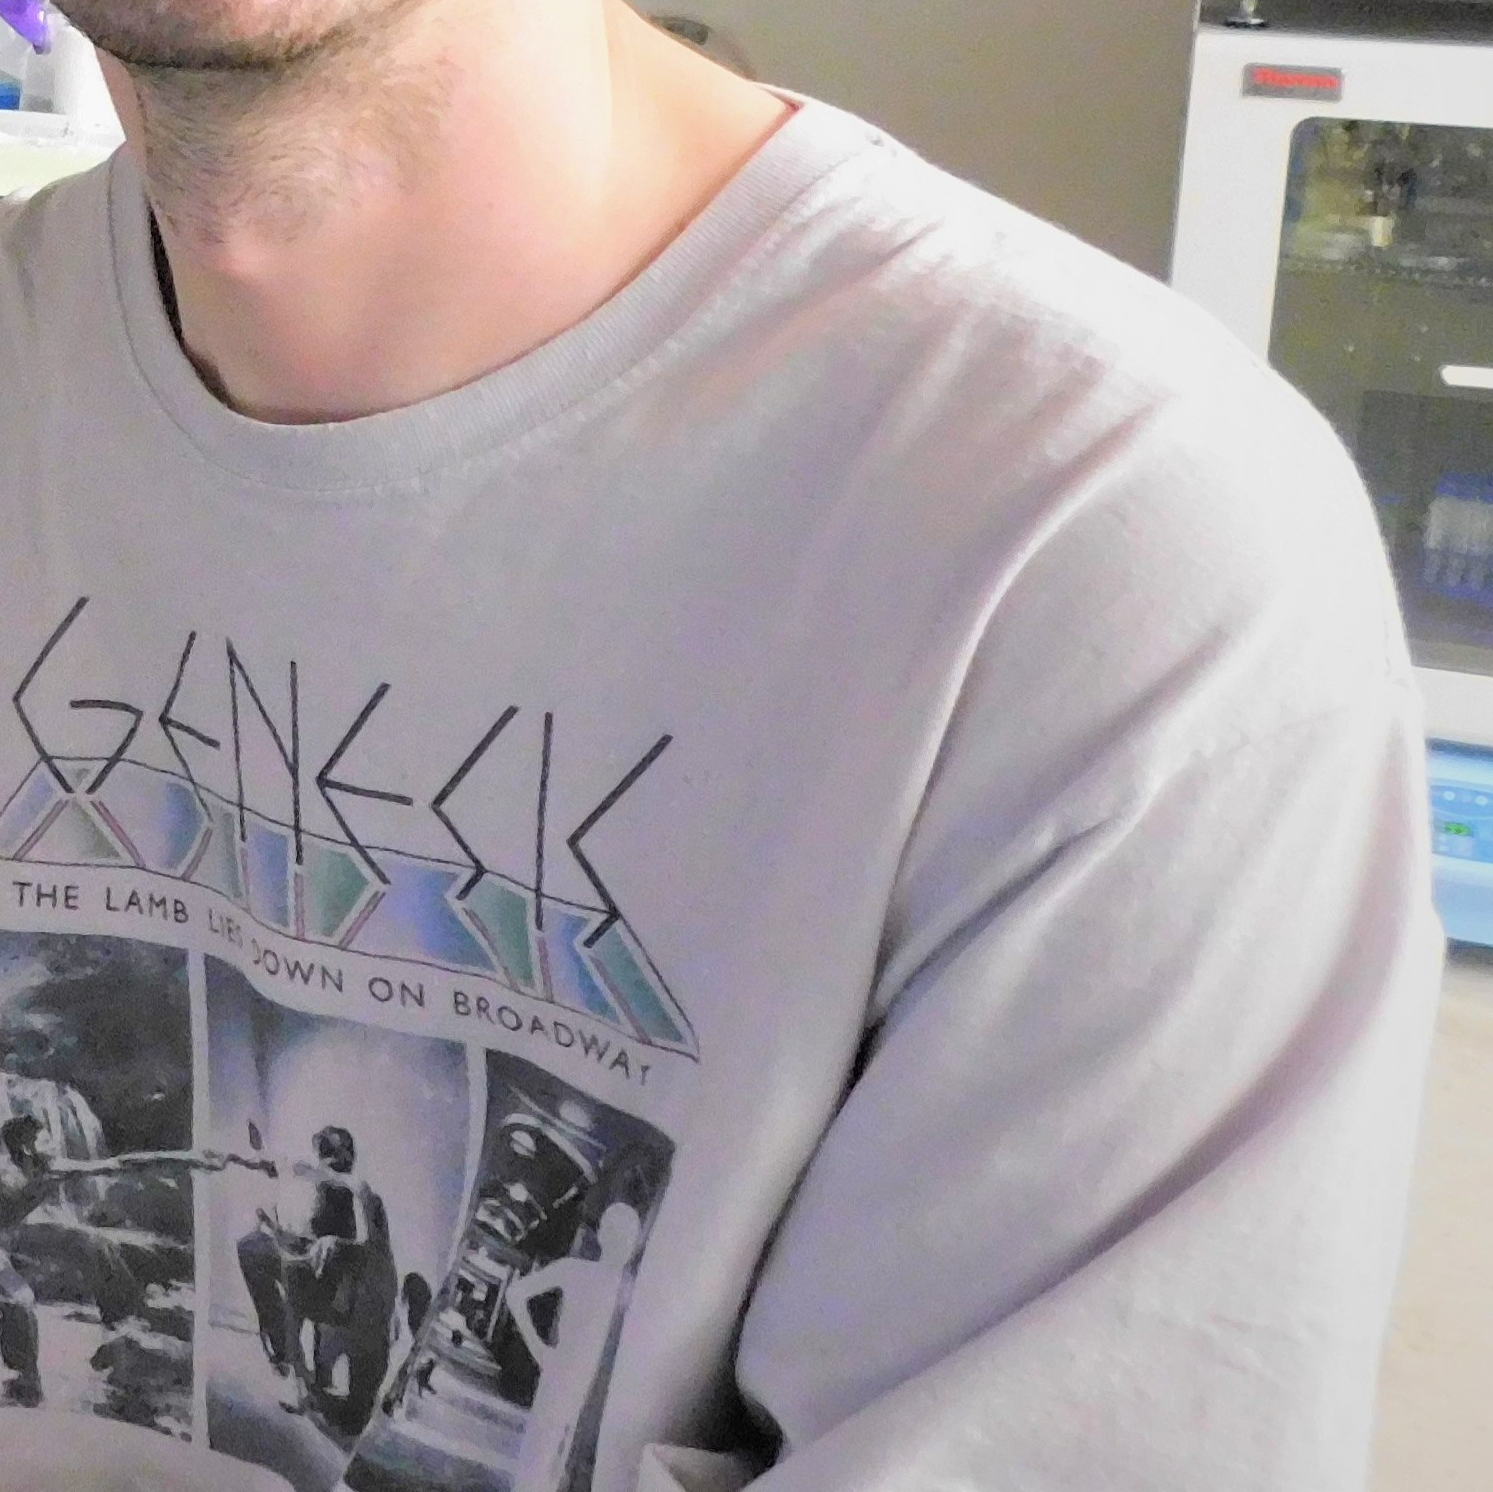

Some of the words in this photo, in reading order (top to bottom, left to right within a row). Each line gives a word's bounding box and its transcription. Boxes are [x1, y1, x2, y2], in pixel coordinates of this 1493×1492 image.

[11, 596, 673, 949] GENESIS
[12, 881, 81, 911] THE
[105, 886, 190, 924] LAMB
[208, 908, 243, 949] LIES
[250, 938, 344, 994] DOWN
[367, 976, 426, 1009] ON
